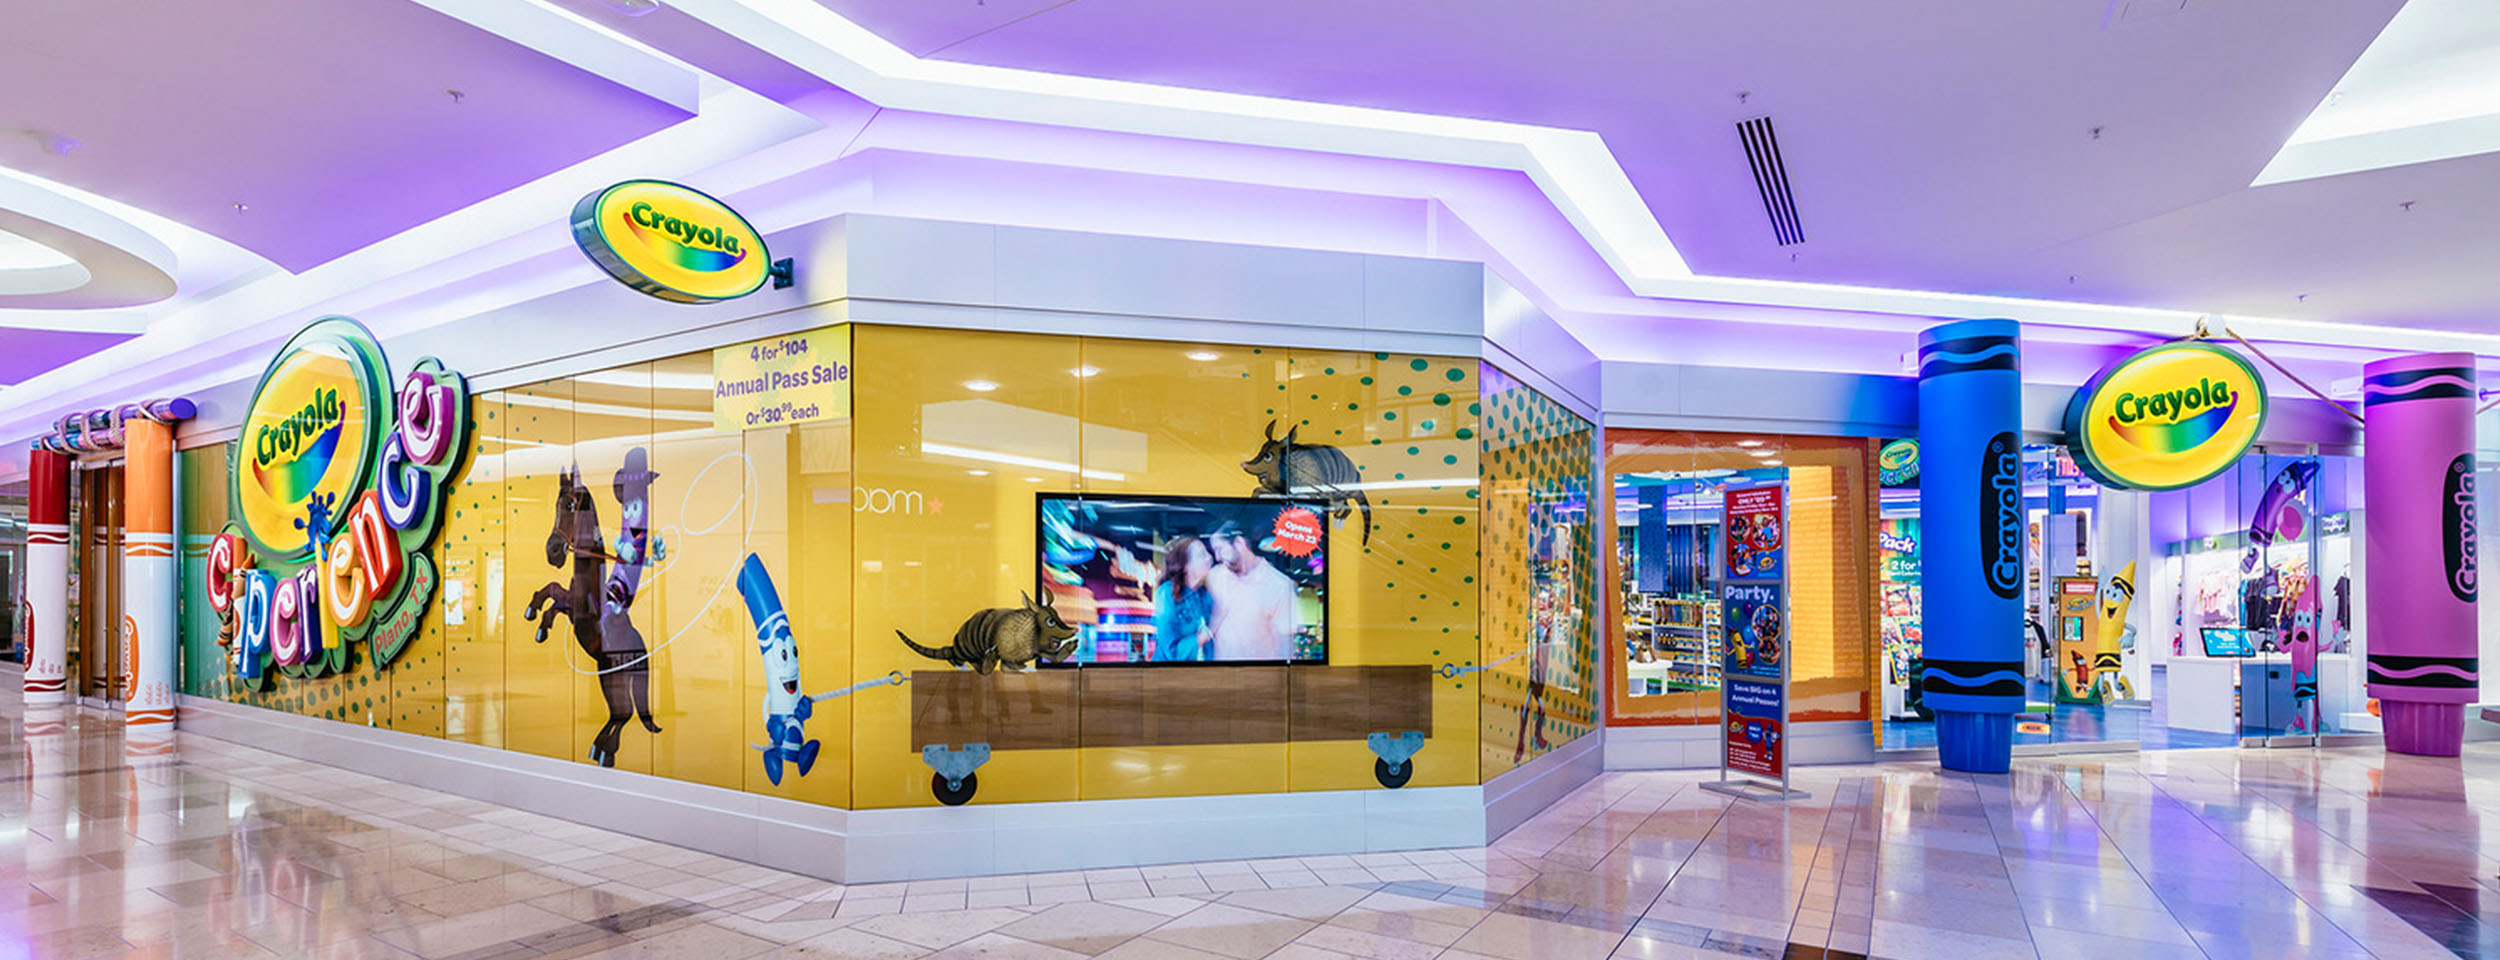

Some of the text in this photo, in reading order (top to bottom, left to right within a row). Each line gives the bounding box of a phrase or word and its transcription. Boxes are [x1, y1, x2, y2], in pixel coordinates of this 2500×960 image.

[632, 202, 739, 254] Crayola
[750, 339, 808, 361] 4 for $104
[716, 361, 848, 398] Annual Pass Sale
[746, 411, 760, 425] Or
[791, 403, 819, 420] each
[2115, 378, 2230, 423] Crayola
[256, 387, 339, 466] Crayola
[1278, 528, 1305, 542] March
[1284, 520, 1312, 534] Opens
[1991, 453, 2021, 590] Crayola
[2454, 472, 2477, 594] Crayola
[1899, 560, 1916, 571] for
[410, 567, 428, 605] TX
[1725, 586, 1774, 603] Party.
